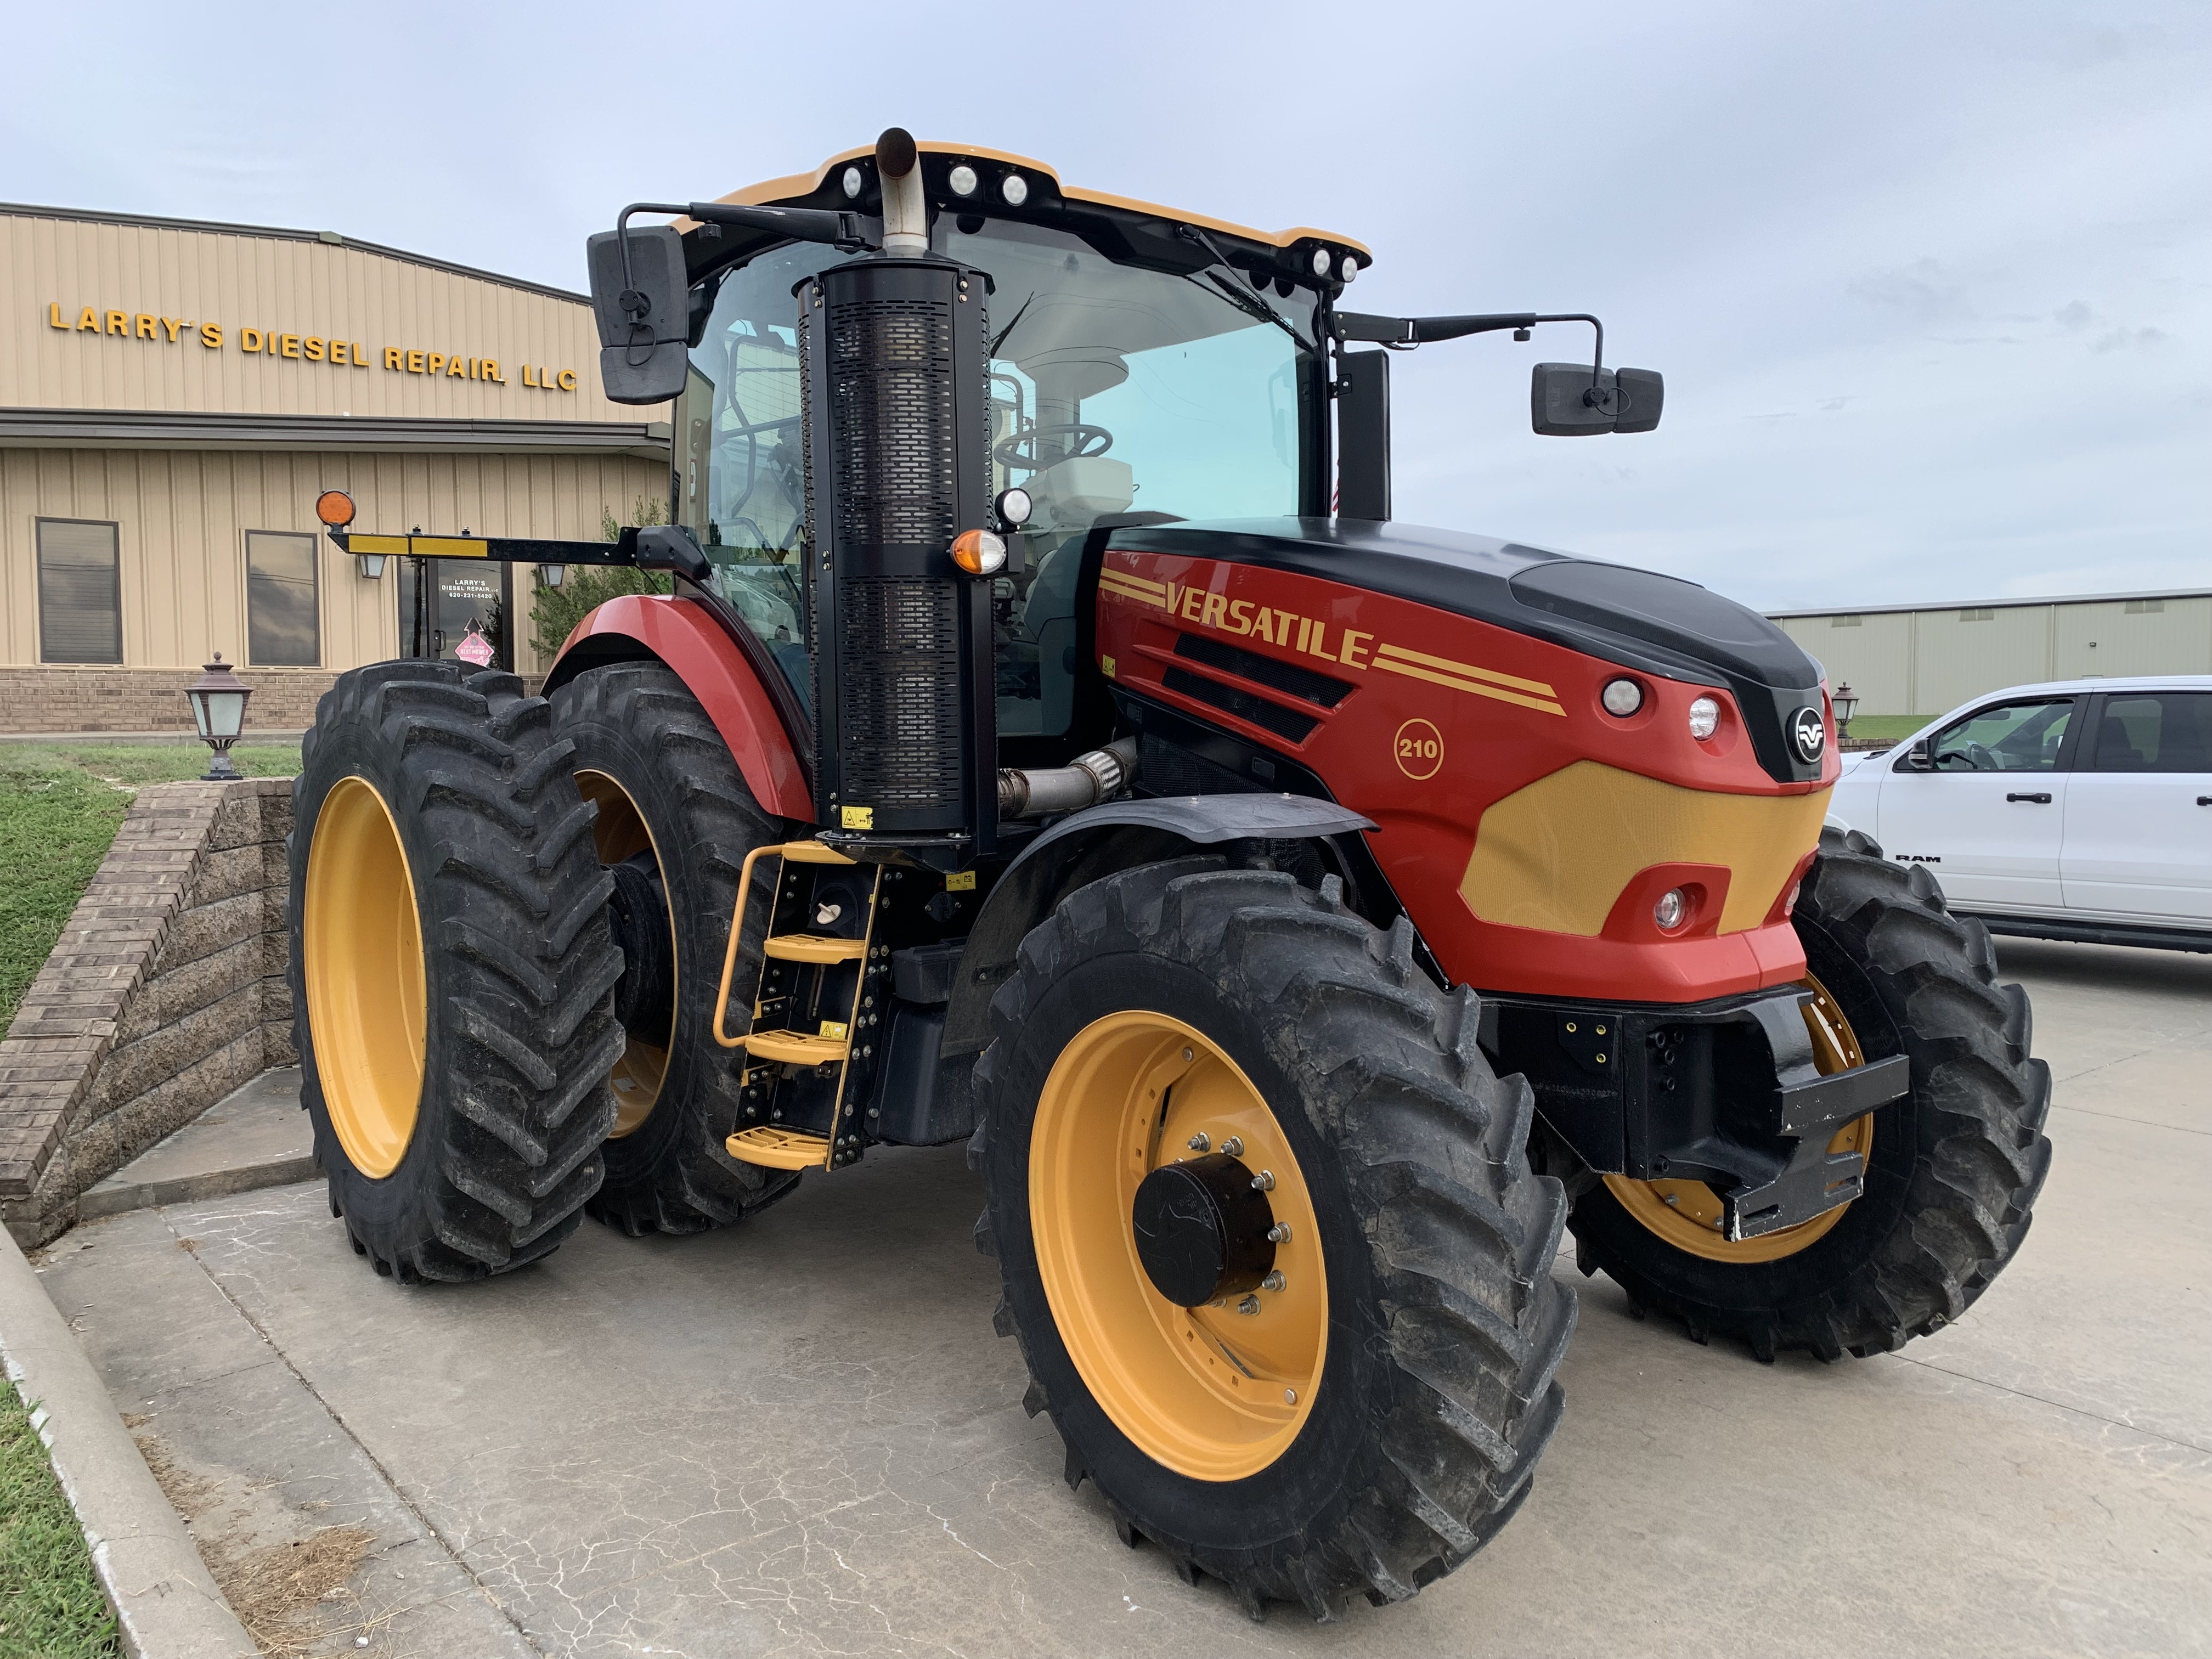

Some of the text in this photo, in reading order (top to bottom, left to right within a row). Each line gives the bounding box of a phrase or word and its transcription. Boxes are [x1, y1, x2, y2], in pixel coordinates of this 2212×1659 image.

[50, 302, 577, 391] LARRY'S DIESEL REPAIR, LLC
[1165, 582, 1375, 670] VERSATILE
[1398, 738, 1438, 759] 210
